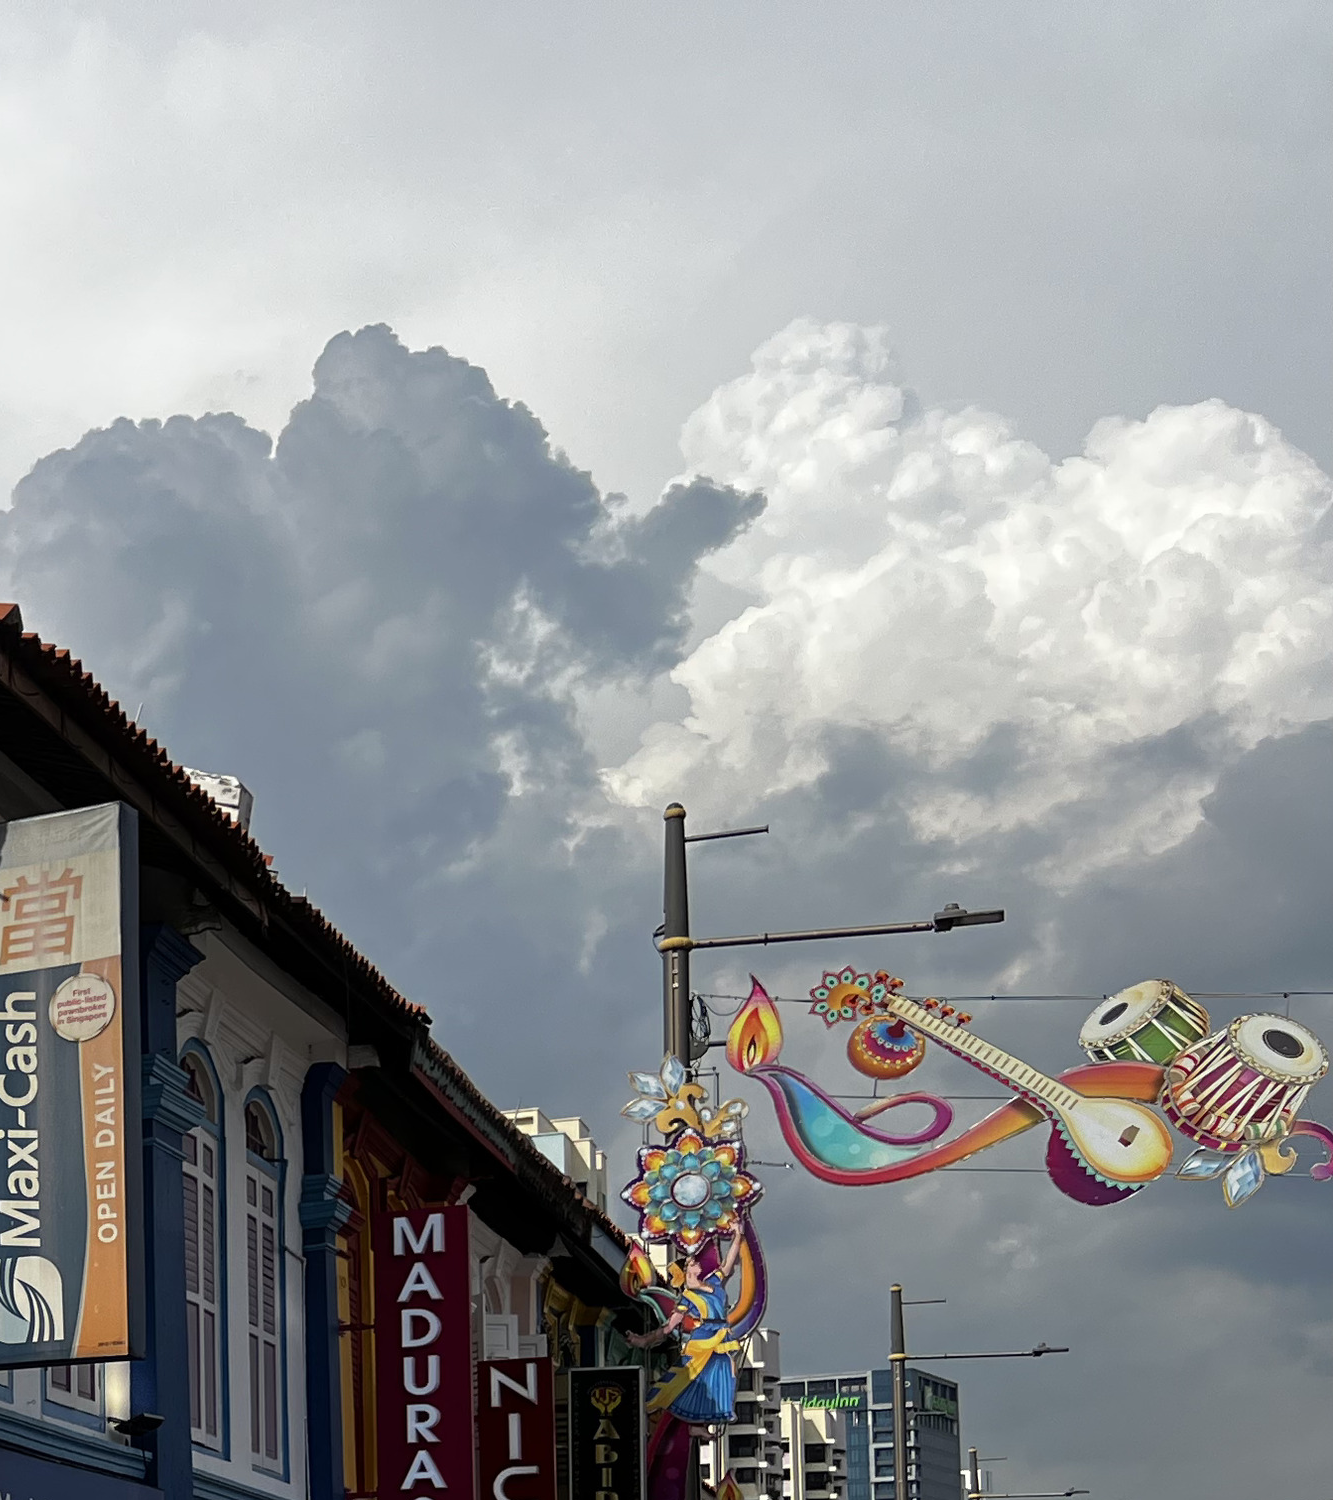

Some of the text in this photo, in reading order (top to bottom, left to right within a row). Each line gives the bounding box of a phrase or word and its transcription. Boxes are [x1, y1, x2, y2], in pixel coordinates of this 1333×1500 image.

[0, 868, 84, 967] 當
[73, 987, 91, 997] First
[93, 1063, 118, 1244] OPEN DAILY
